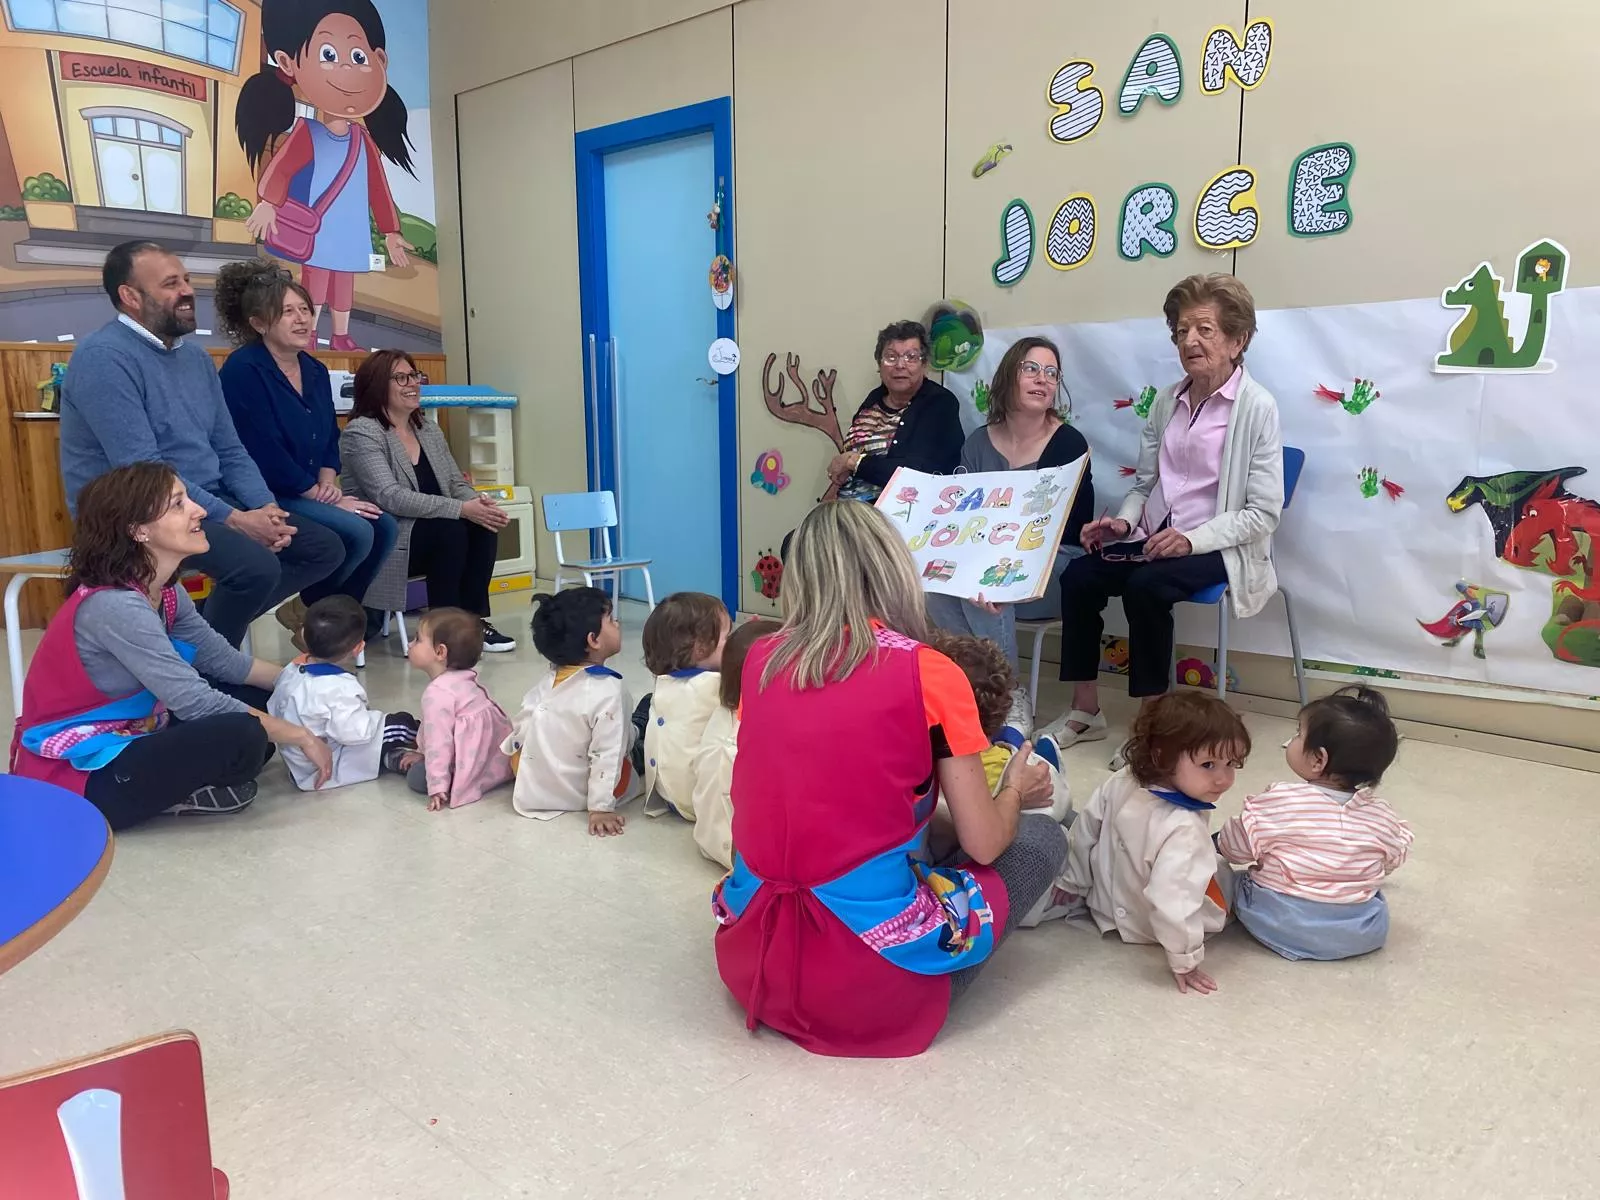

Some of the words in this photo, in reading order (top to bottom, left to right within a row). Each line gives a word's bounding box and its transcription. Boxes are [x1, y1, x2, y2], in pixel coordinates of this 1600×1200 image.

[71, 62, 132, 79] Escuela
[138, 65, 196, 97] infantil
[1047, 17, 1275, 144] SAN
[992, 142, 1356, 286] JORGE
